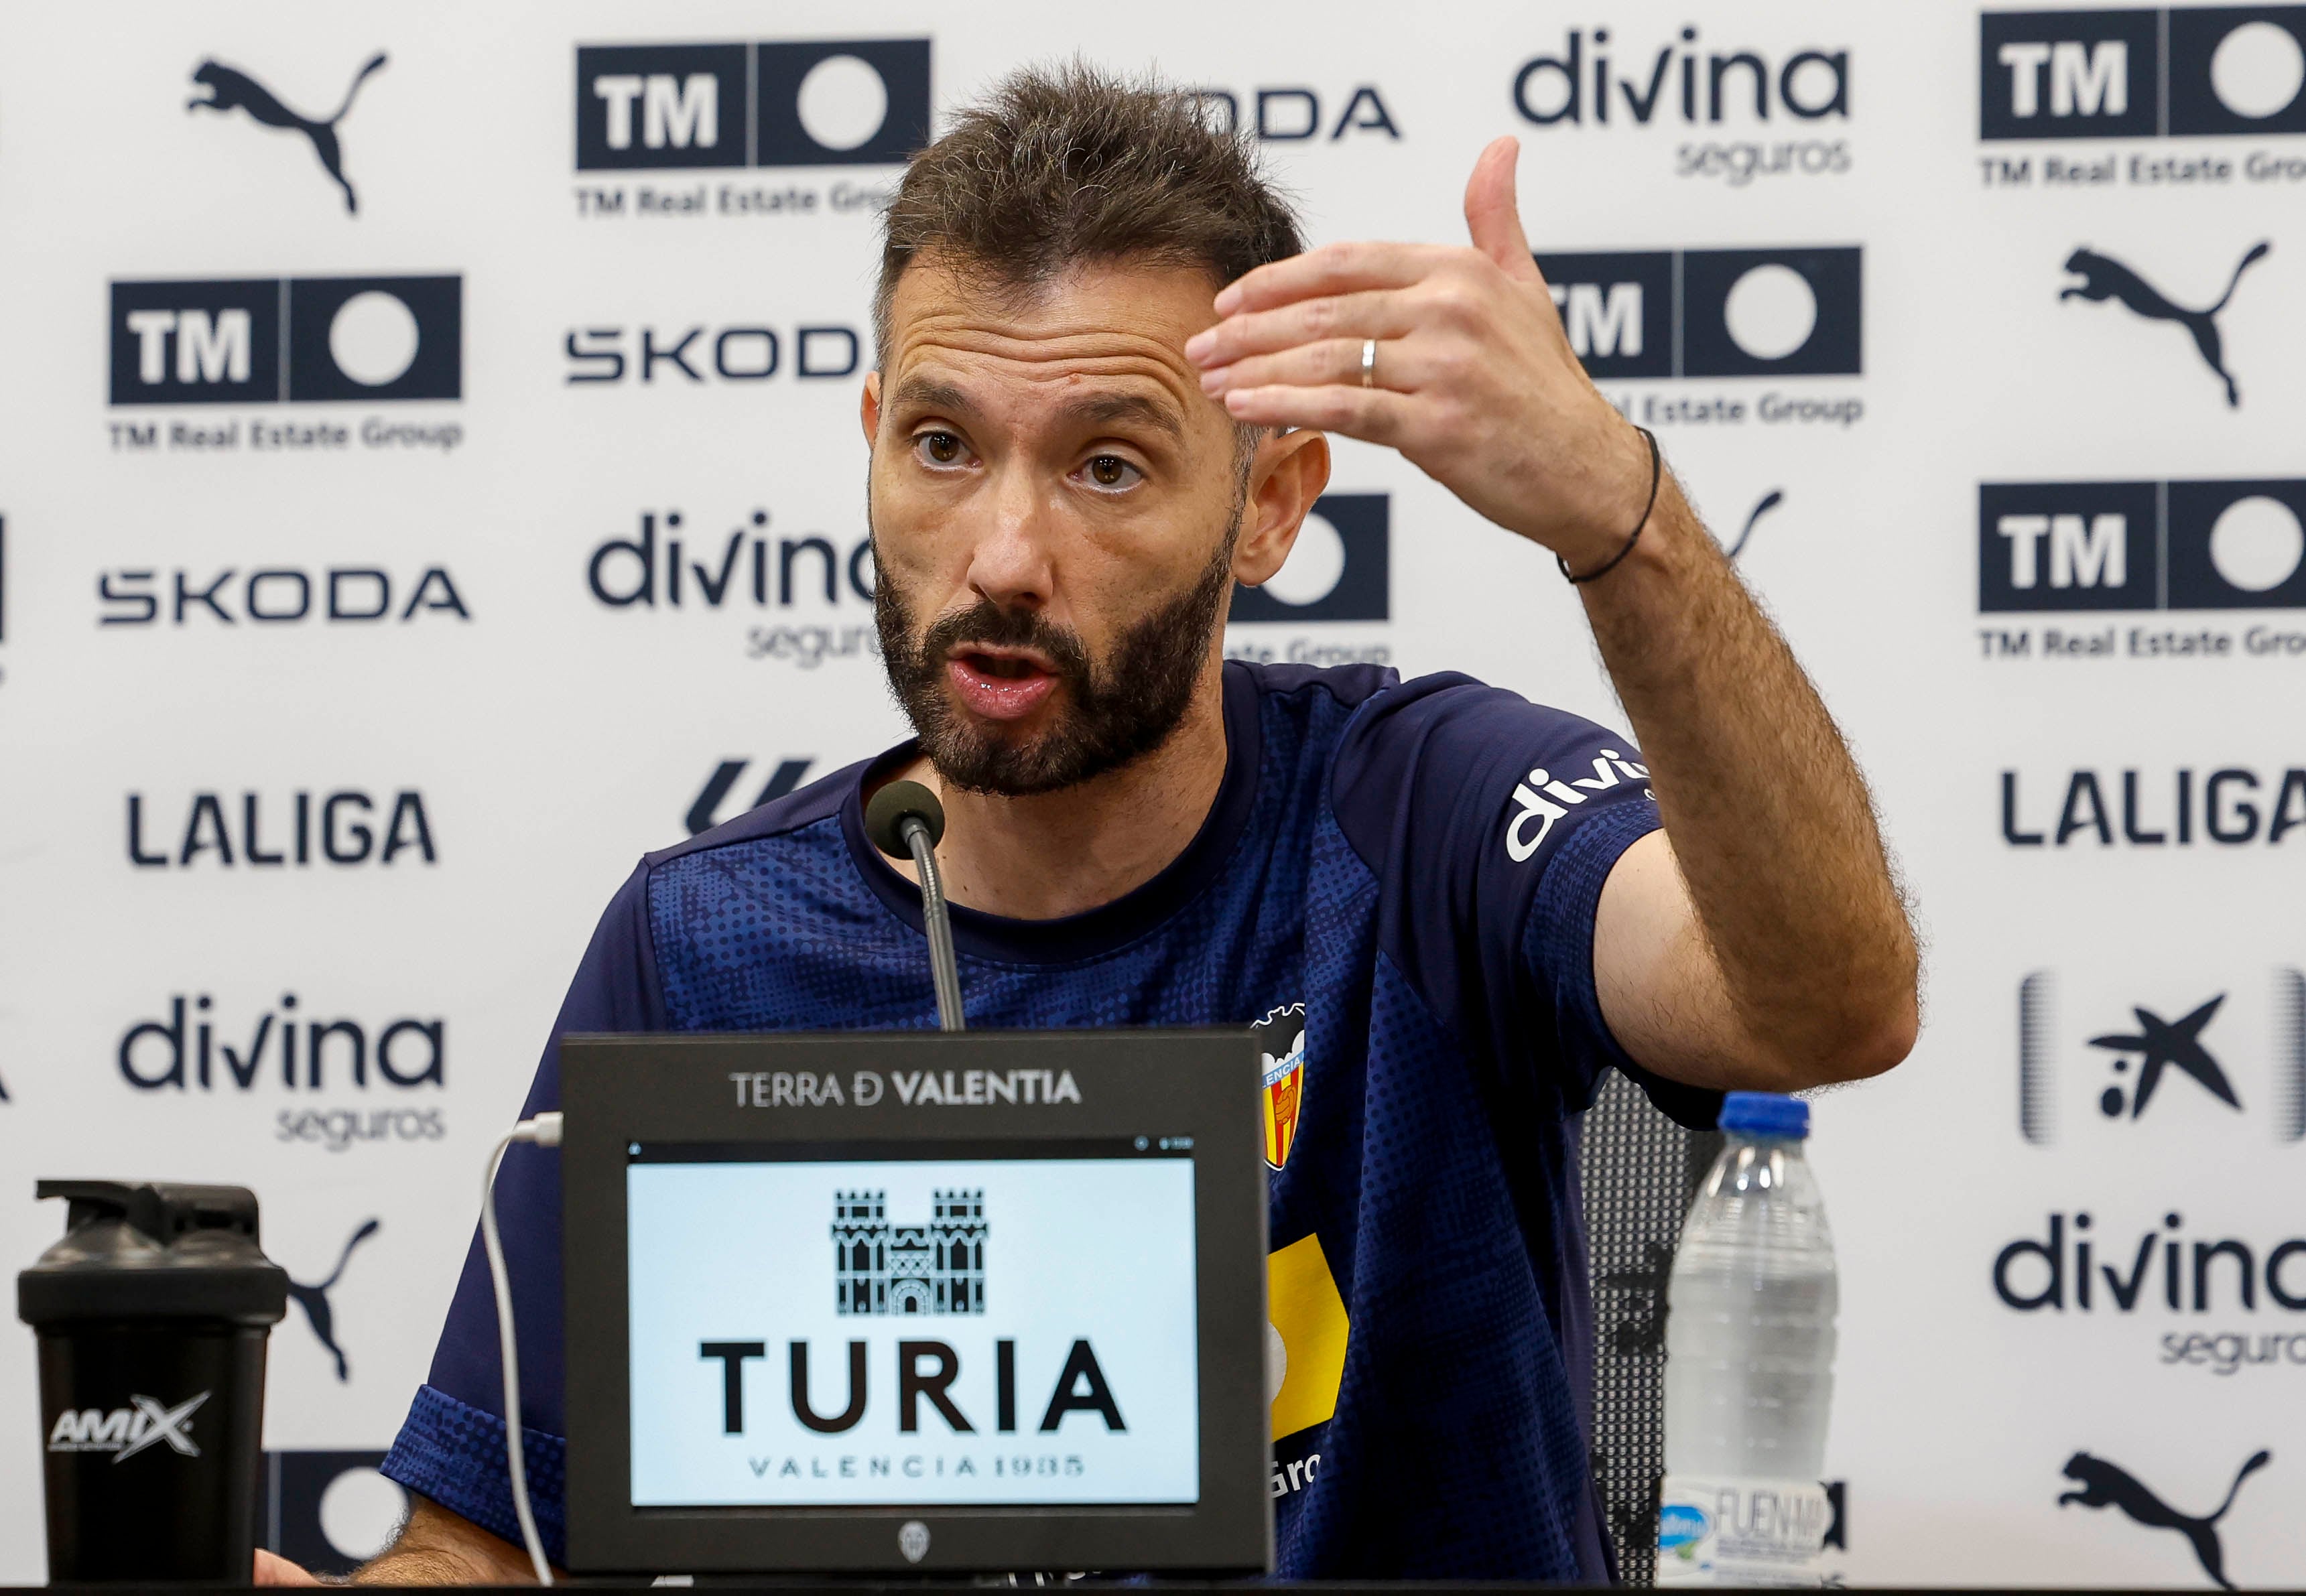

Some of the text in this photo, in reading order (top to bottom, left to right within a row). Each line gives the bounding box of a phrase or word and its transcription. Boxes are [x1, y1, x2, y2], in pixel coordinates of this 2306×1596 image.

[1512, 25, 1850, 127] divina
[1998, 40, 2128, 118] TM
[594, 73, 718, 149] TM
[1677, 139, 1852, 186] seguros
[1981, 157, 2031, 185] TM
[2044, 155, 2116, 184] Real
[2128, 153, 2232, 184] Estate
[578, 188, 625, 216] TM
[637, 186, 706, 214] Real
[717, 184, 817, 214] Estate
[127, 308, 251, 385] TM
[566, 326, 873, 382] SKOD
[110, 416, 464, 452] TM Real Estate Group
[1644, 393, 1746, 425] Estate
[1756, 391, 1864, 428] Group
[1998, 513, 2127, 589] TM
[99, 567, 470, 627] SKODA
[1980, 630, 2031, 658] TM
[2043, 628, 2115, 658] Real
[2127, 627, 2232, 657] Estate
[127, 791, 438, 868] LALIGA
[1507, 749, 1651, 862] divi
[117, 992, 446, 1091] divina
[730, 1072, 844, 1107] TERRA
[891, 1069, 1082, 1106] VALENTIA
[1263, 1056, 1300, 1088] ENCIA
[276, 1108, 446, 1153] seguros
[698, 1338, 1129, 1436] TURIA
[48, 1389, 213, 1465] AMIX
[749, 1455, 977, 1479] VALENCIA
